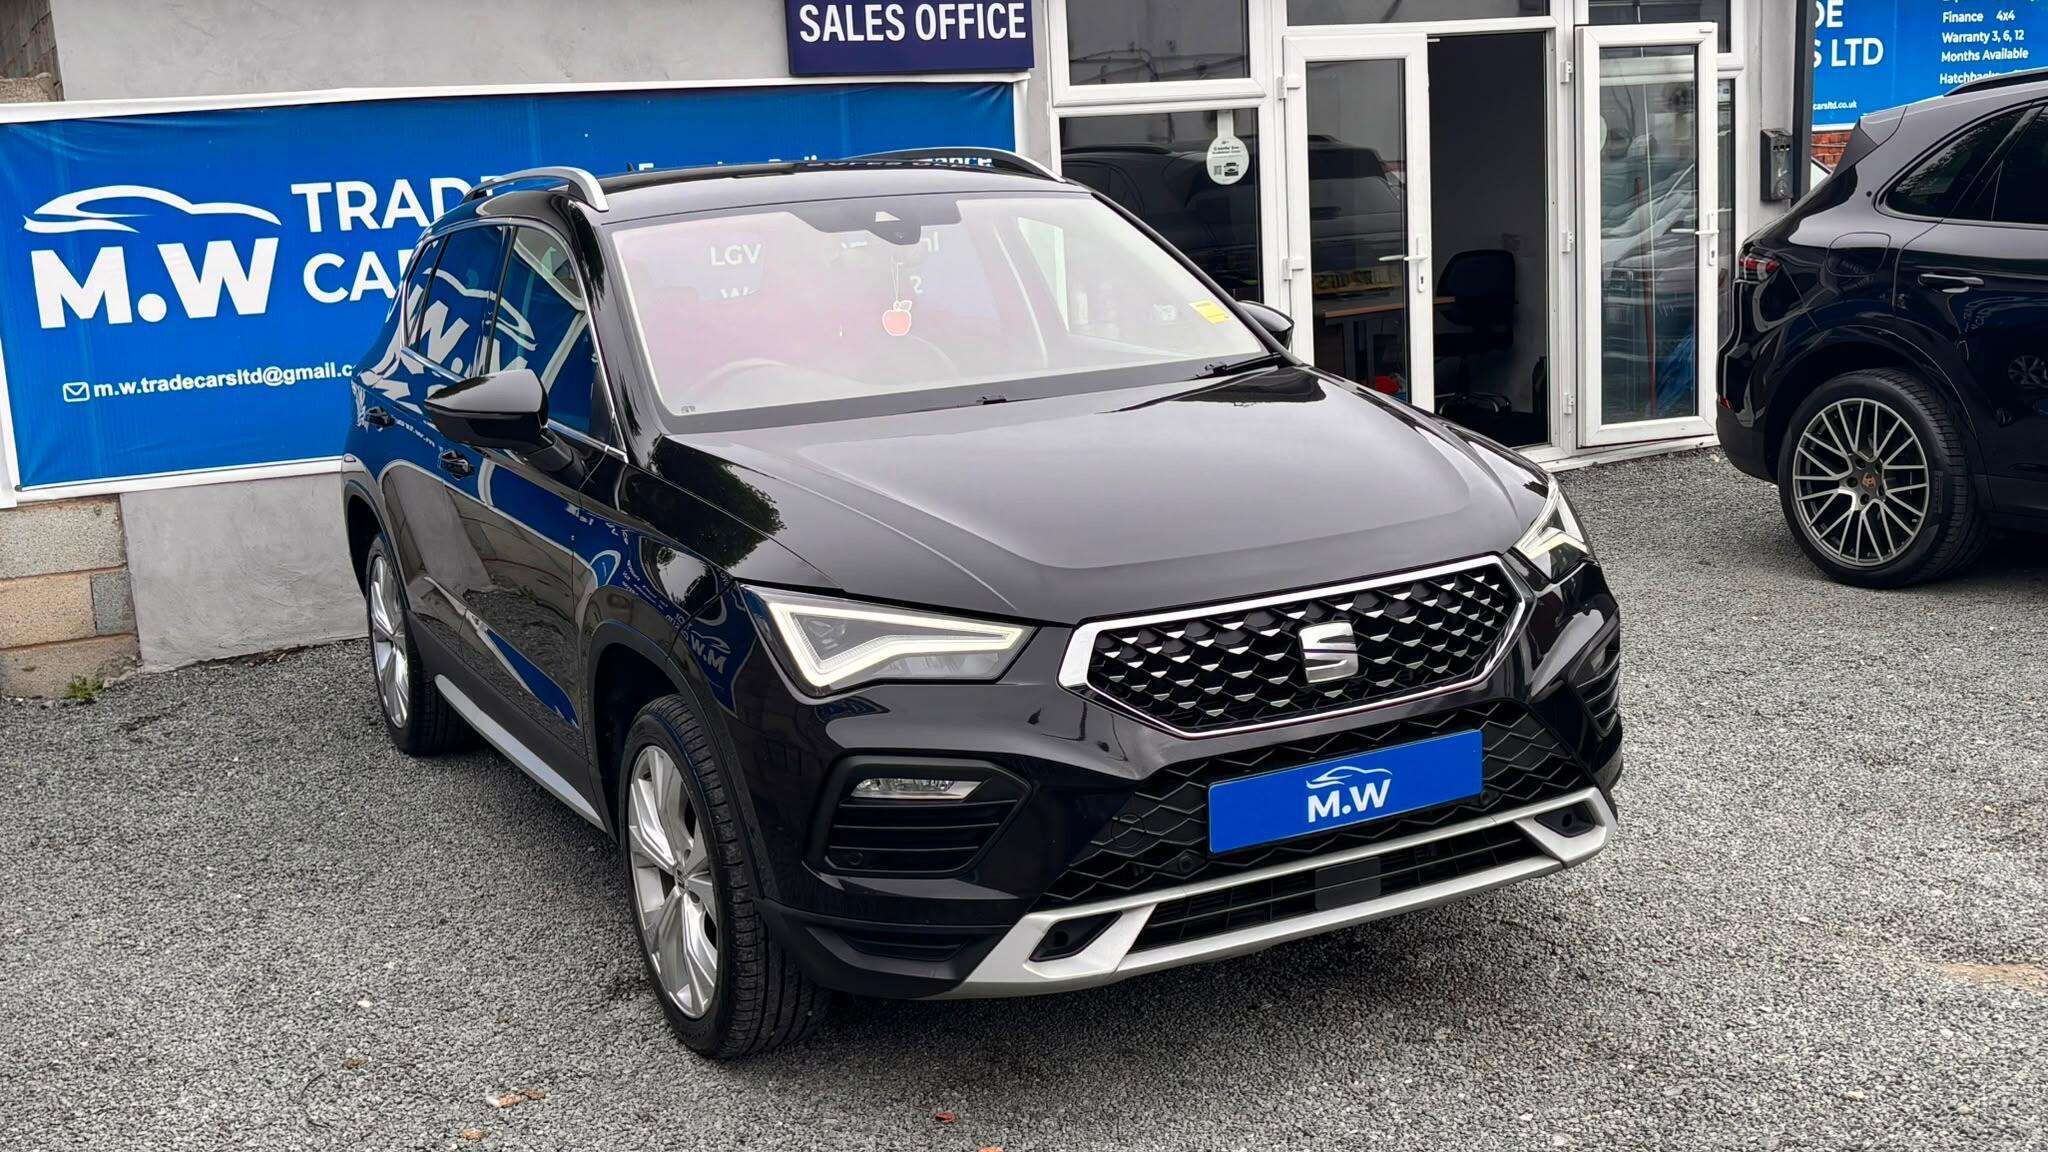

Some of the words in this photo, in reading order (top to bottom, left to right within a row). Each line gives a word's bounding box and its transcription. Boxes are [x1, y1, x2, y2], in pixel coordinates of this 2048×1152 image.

[800, 4, 906, 42] SALES
[915, 3, 1027, 40] OFFICE
[1942, 10, 1984, 23] Finance
[1996, 10, 2015, 21] 4x4
[1831, 37, 1884, 67] LTD
[1941, 31, 1990, 45] Warranty
[2014, 29, 2025, 41] 12
[1941, 50, 1980, 62] Months
[1982, 47, 2029, 61] Available
[710, 244, 762, 266] LGV
[31, 237, 279, 329] M.W
[303, 249, 415, 304] CA
[1307, 778, 1392, 824] M.W
